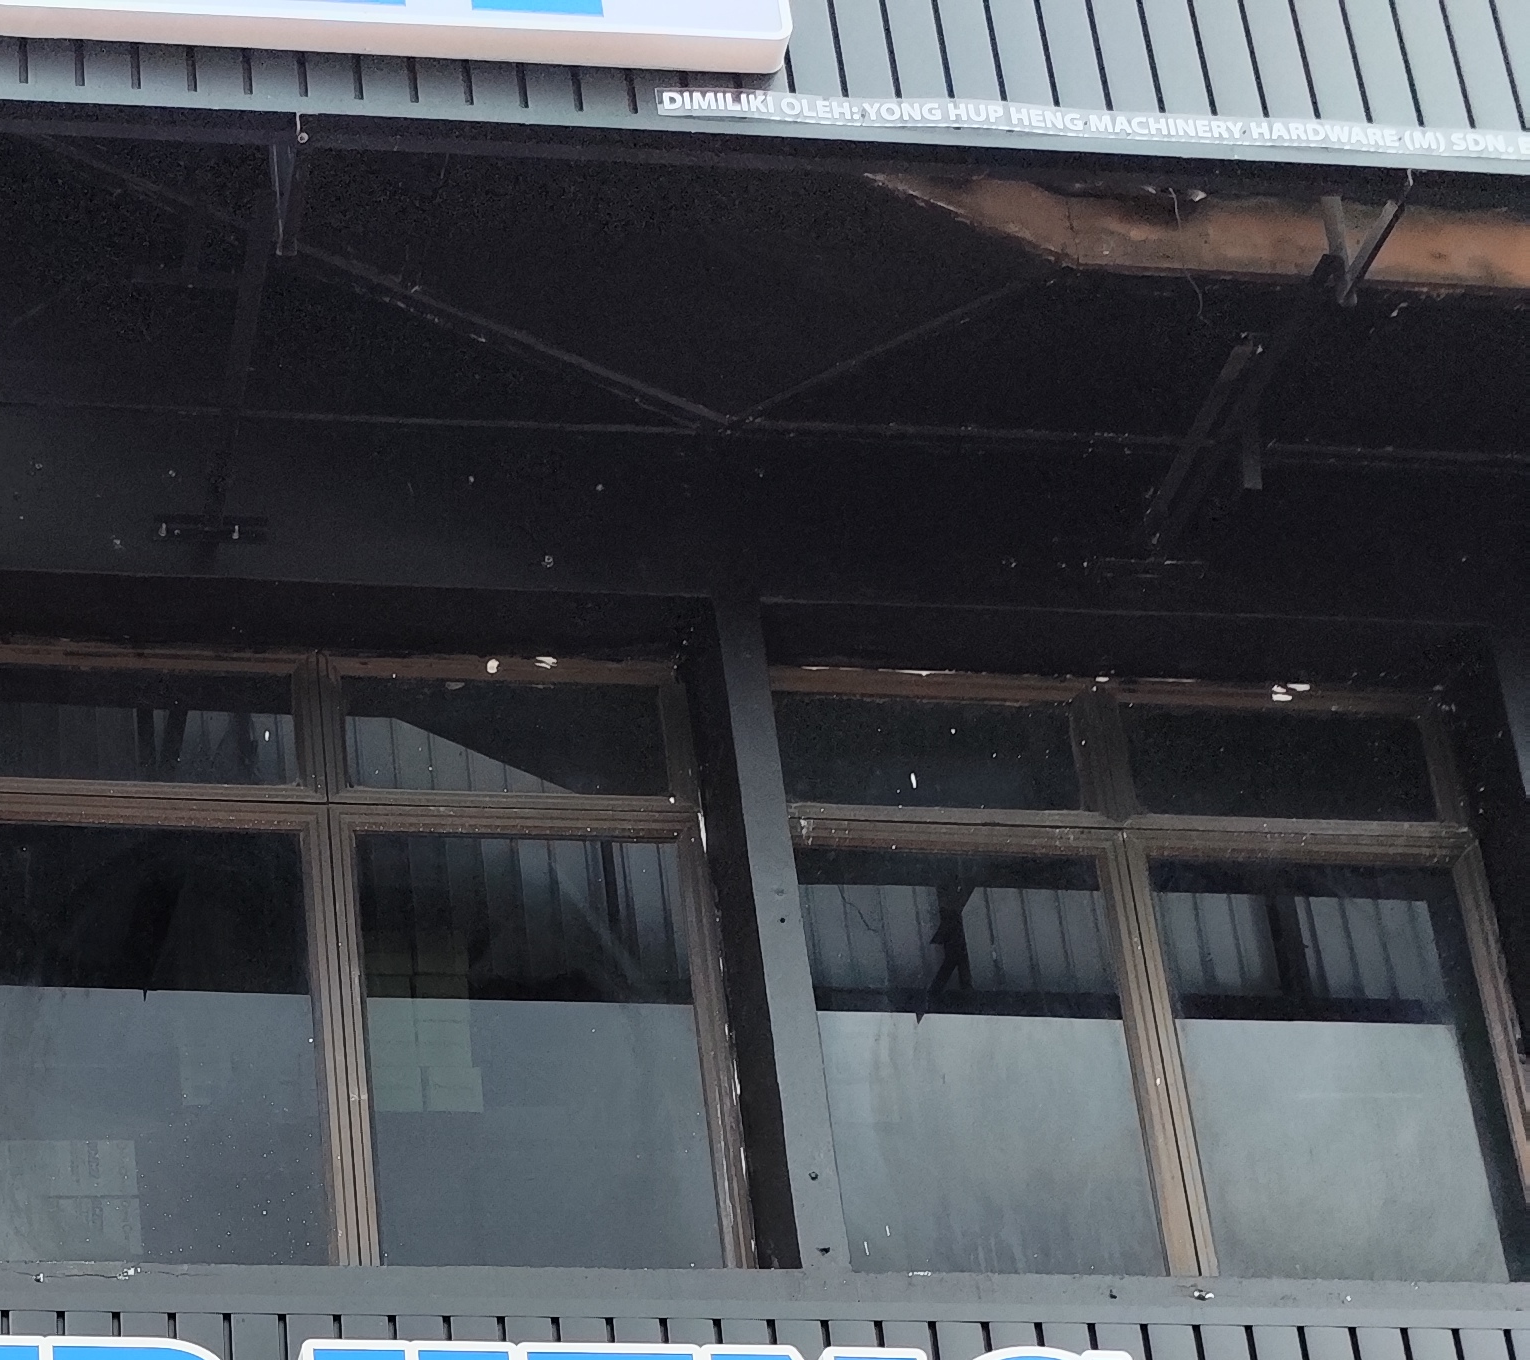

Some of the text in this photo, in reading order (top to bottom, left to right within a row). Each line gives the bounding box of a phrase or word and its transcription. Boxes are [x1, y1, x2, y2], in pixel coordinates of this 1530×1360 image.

[662, 91, 774, 113] DIMILIKI
[780, 98, 859, 120] OLEH:
[864, 102, 942, 121] YONG
[952, 104, 1003, 123] HUP
[1011, 107, 1083, 131] HENG
[1088, 114, 1243, 139] MACHINERY
[1250, 122, 1399, 148] HARDWARE
[1404, 131, 1446, 152] (M)
[1451, 132, 1515, 153] SDN.
